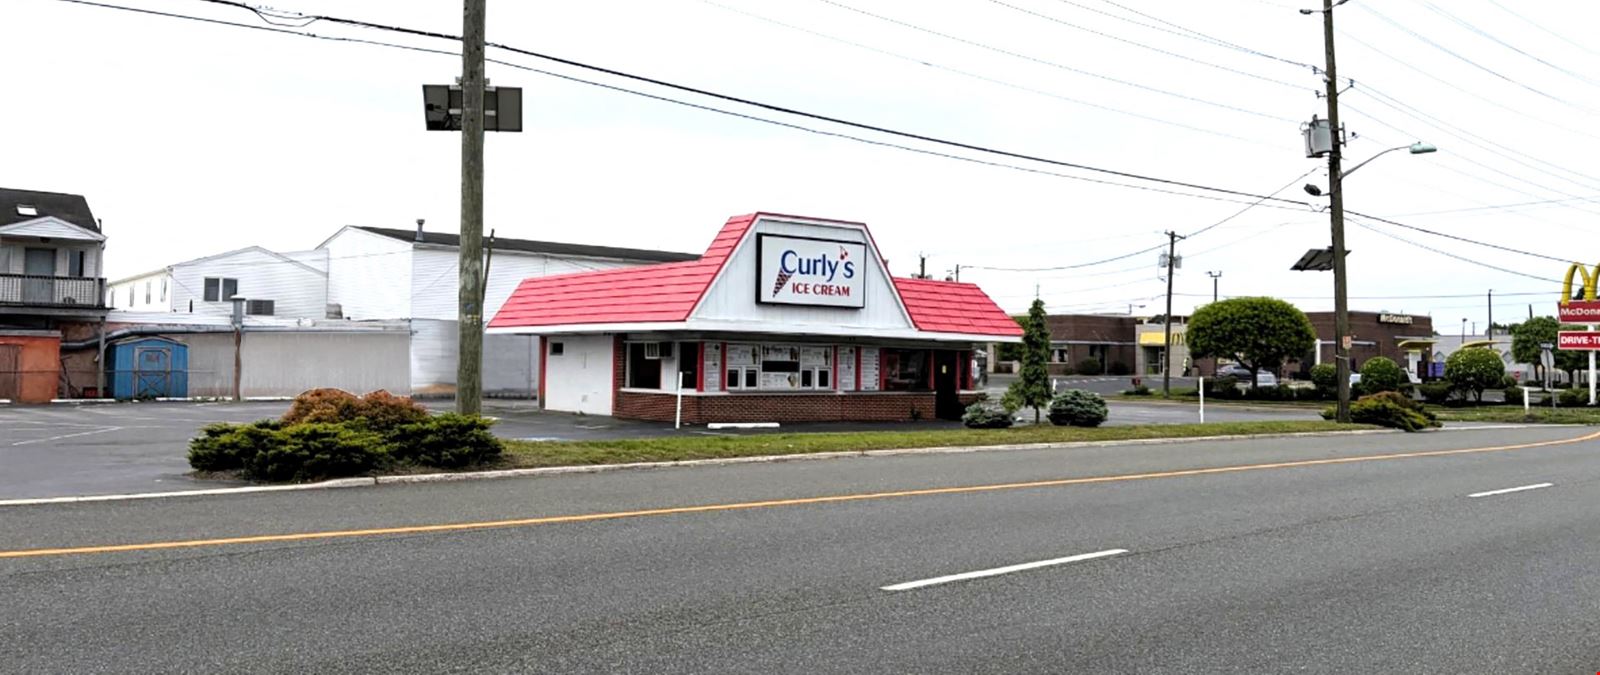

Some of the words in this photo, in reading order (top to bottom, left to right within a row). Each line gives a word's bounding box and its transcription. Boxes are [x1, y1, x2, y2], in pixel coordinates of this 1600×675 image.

[781, 249, 855, 283] Curly's
[792, 282, 810, 294] ICE
[813, 284, 850, 297] CREAM
